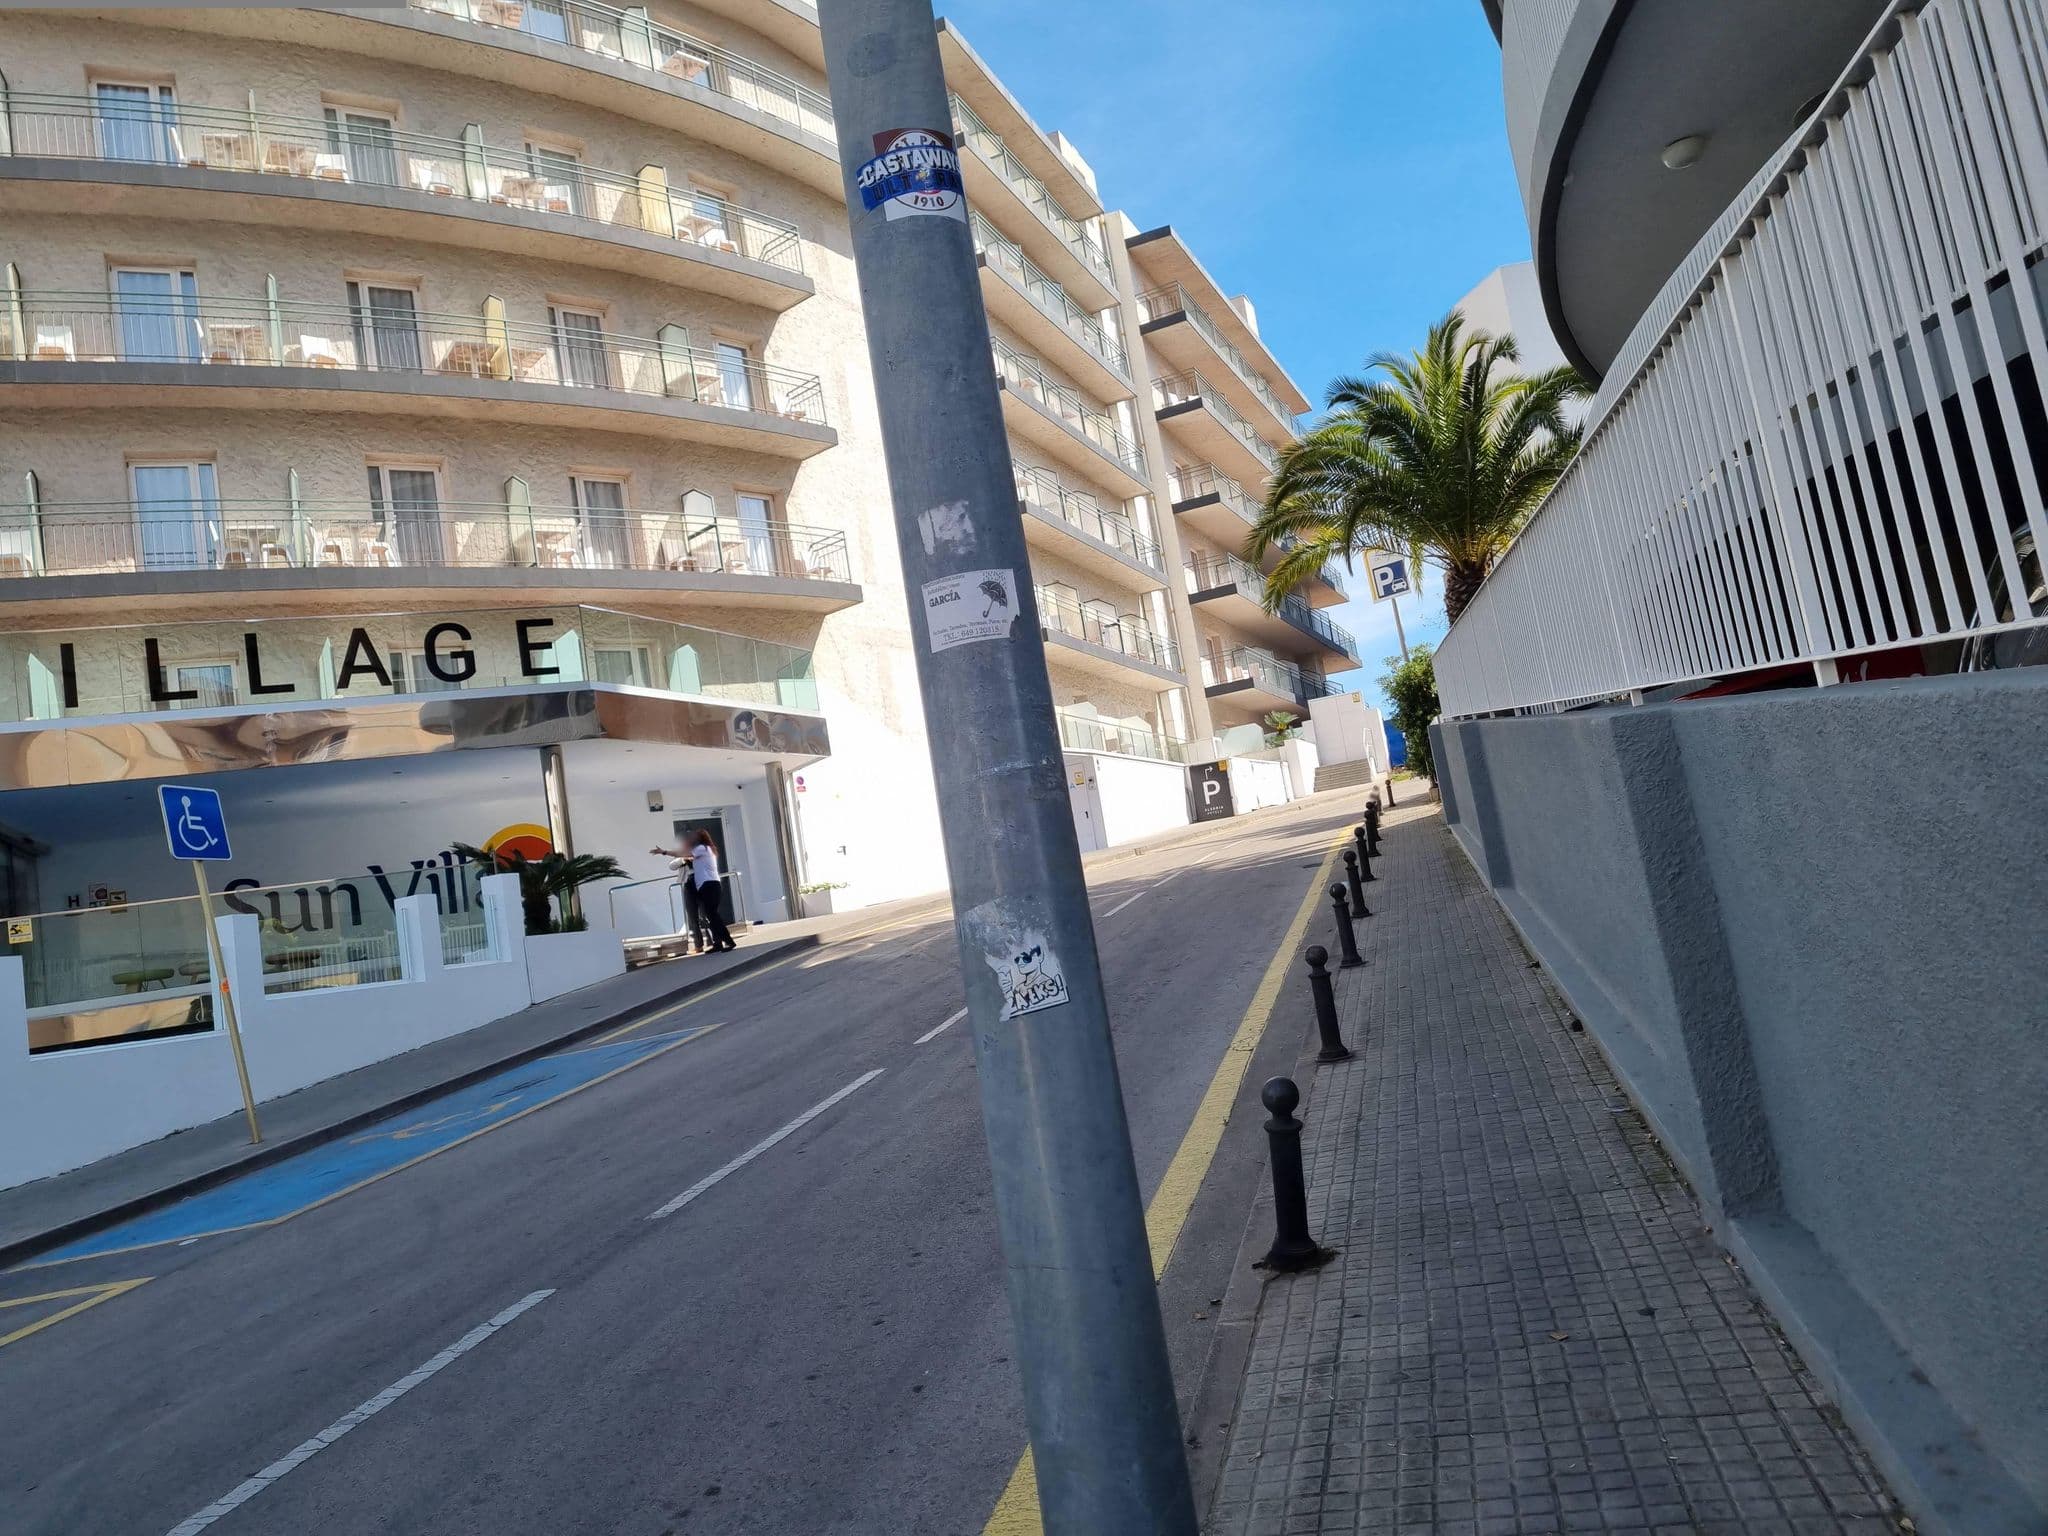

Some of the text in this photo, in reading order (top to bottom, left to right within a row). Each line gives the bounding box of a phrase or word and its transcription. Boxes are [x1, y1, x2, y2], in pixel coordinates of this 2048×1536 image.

[913, 194, 945, 208] 1910
[1374, 566, 1395, 597] P
[928, 589, 961, 608] GARCÍA
[60, 617, 561, 708] ILLAGE
[1202, 780, 1221, 805] P
[223, 878, 363, 935] Sun
